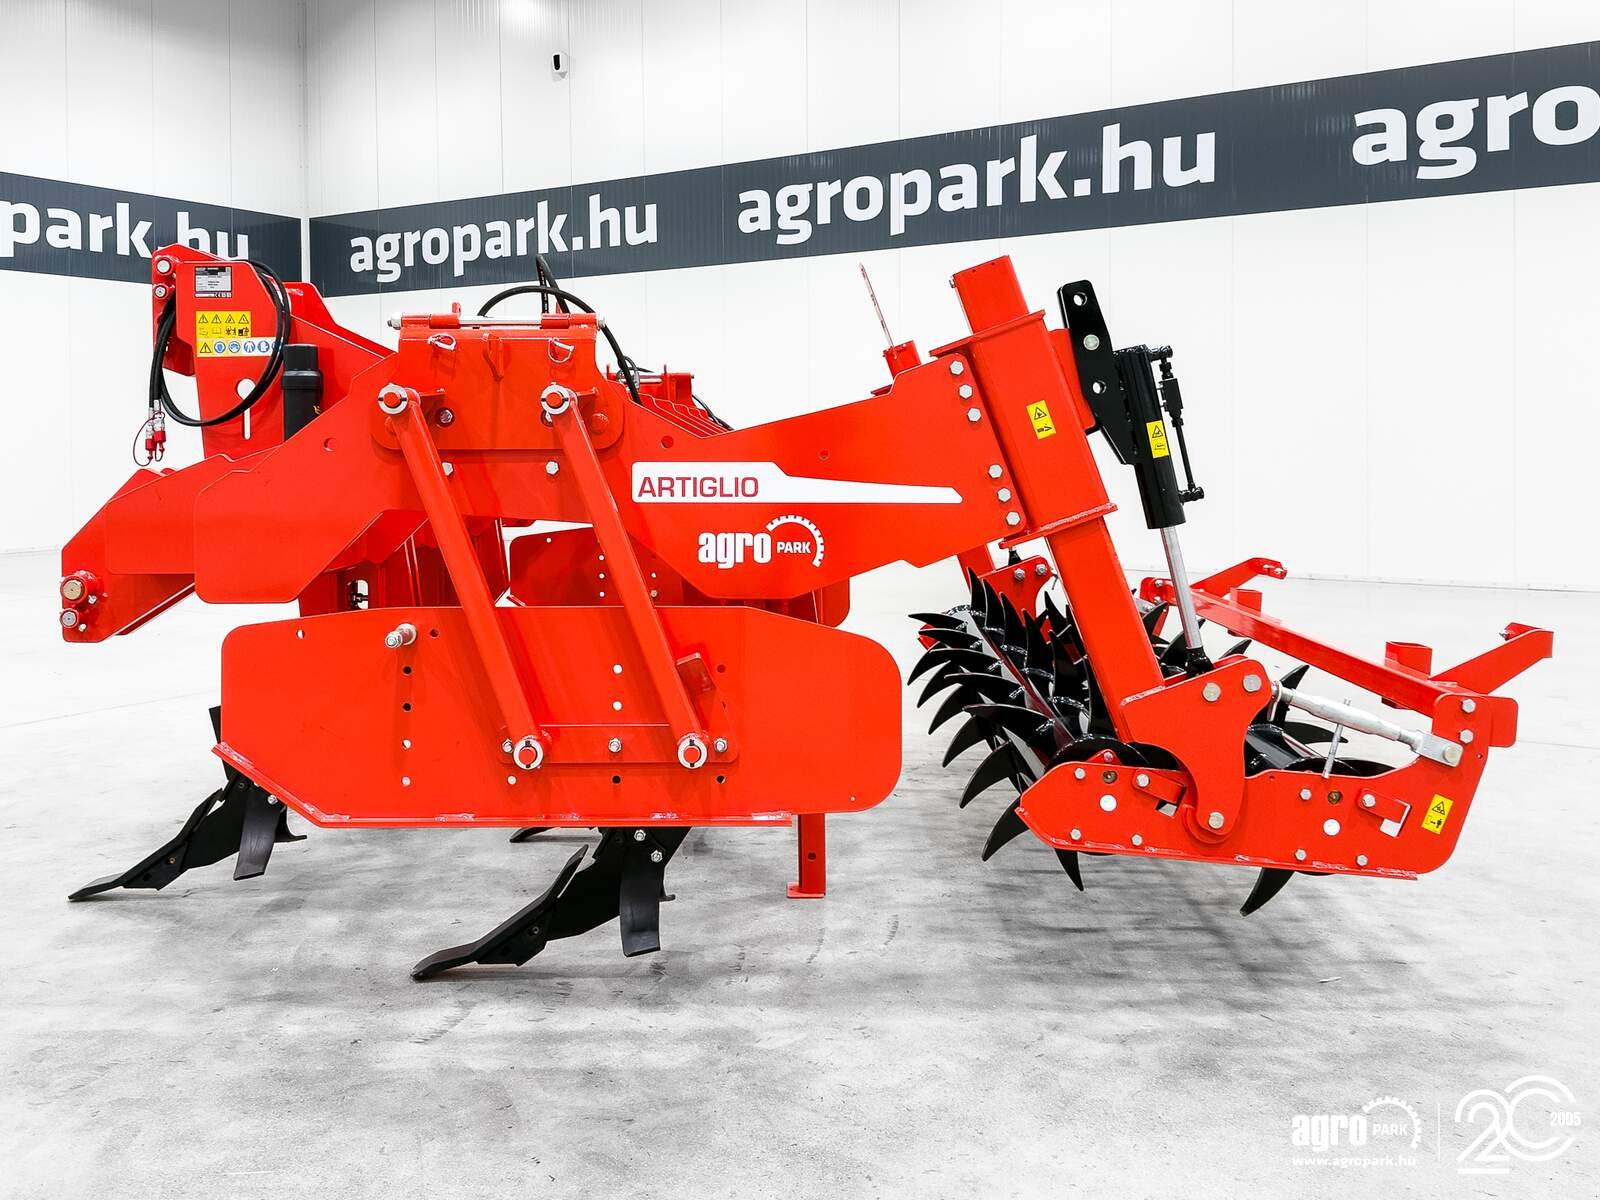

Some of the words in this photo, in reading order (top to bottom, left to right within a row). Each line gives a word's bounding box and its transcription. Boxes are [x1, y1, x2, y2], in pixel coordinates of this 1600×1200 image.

[1353, 84, 1600, 180] agro
[738, 123, 1216, 245] agropark.hu
[0, 200, 249, 260] parkhu
[350, 193, 658, 284] agropark.hu
[637, 476, 760, 498] ARTIGLIO
[698, 532, 772, 569] agro
[776, 541, 812, 554] PARK
